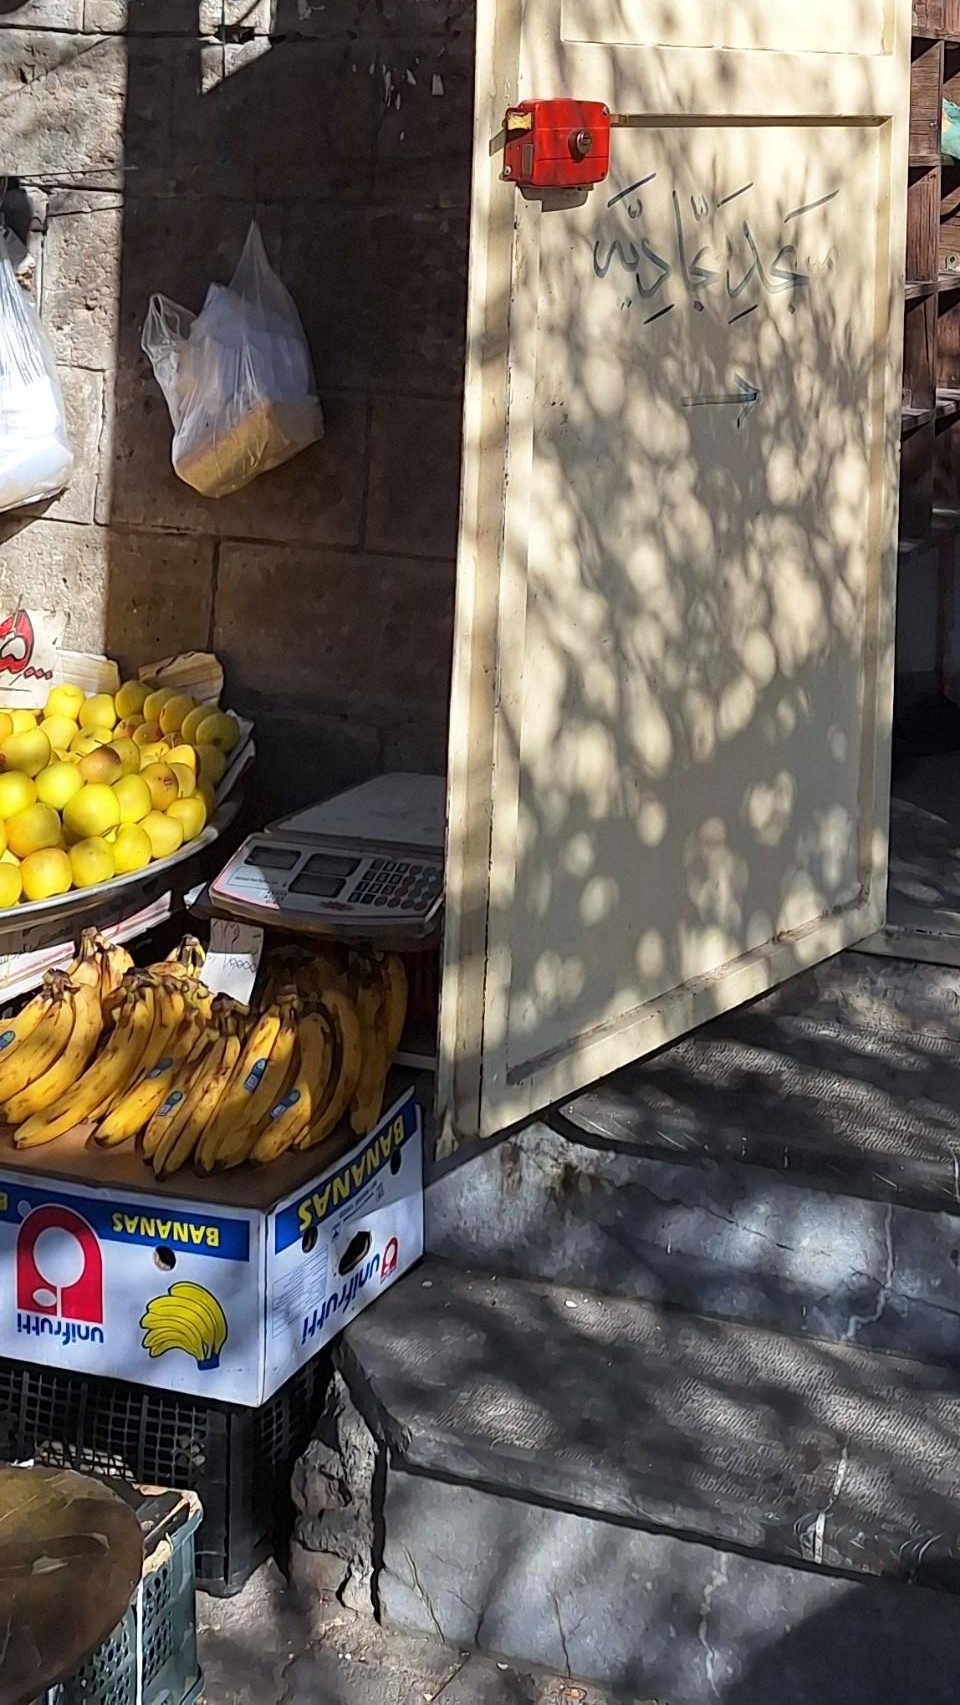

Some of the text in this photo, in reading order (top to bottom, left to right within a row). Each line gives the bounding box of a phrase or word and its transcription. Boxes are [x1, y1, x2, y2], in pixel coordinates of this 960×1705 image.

[298, 1113, 405, 1231] BANANAS
[111, 1211, 220, 1248] BANANAS
[16, 1312, 105, 1346] unifrutti
[301, 1251, 381, 1346] unifrutti
